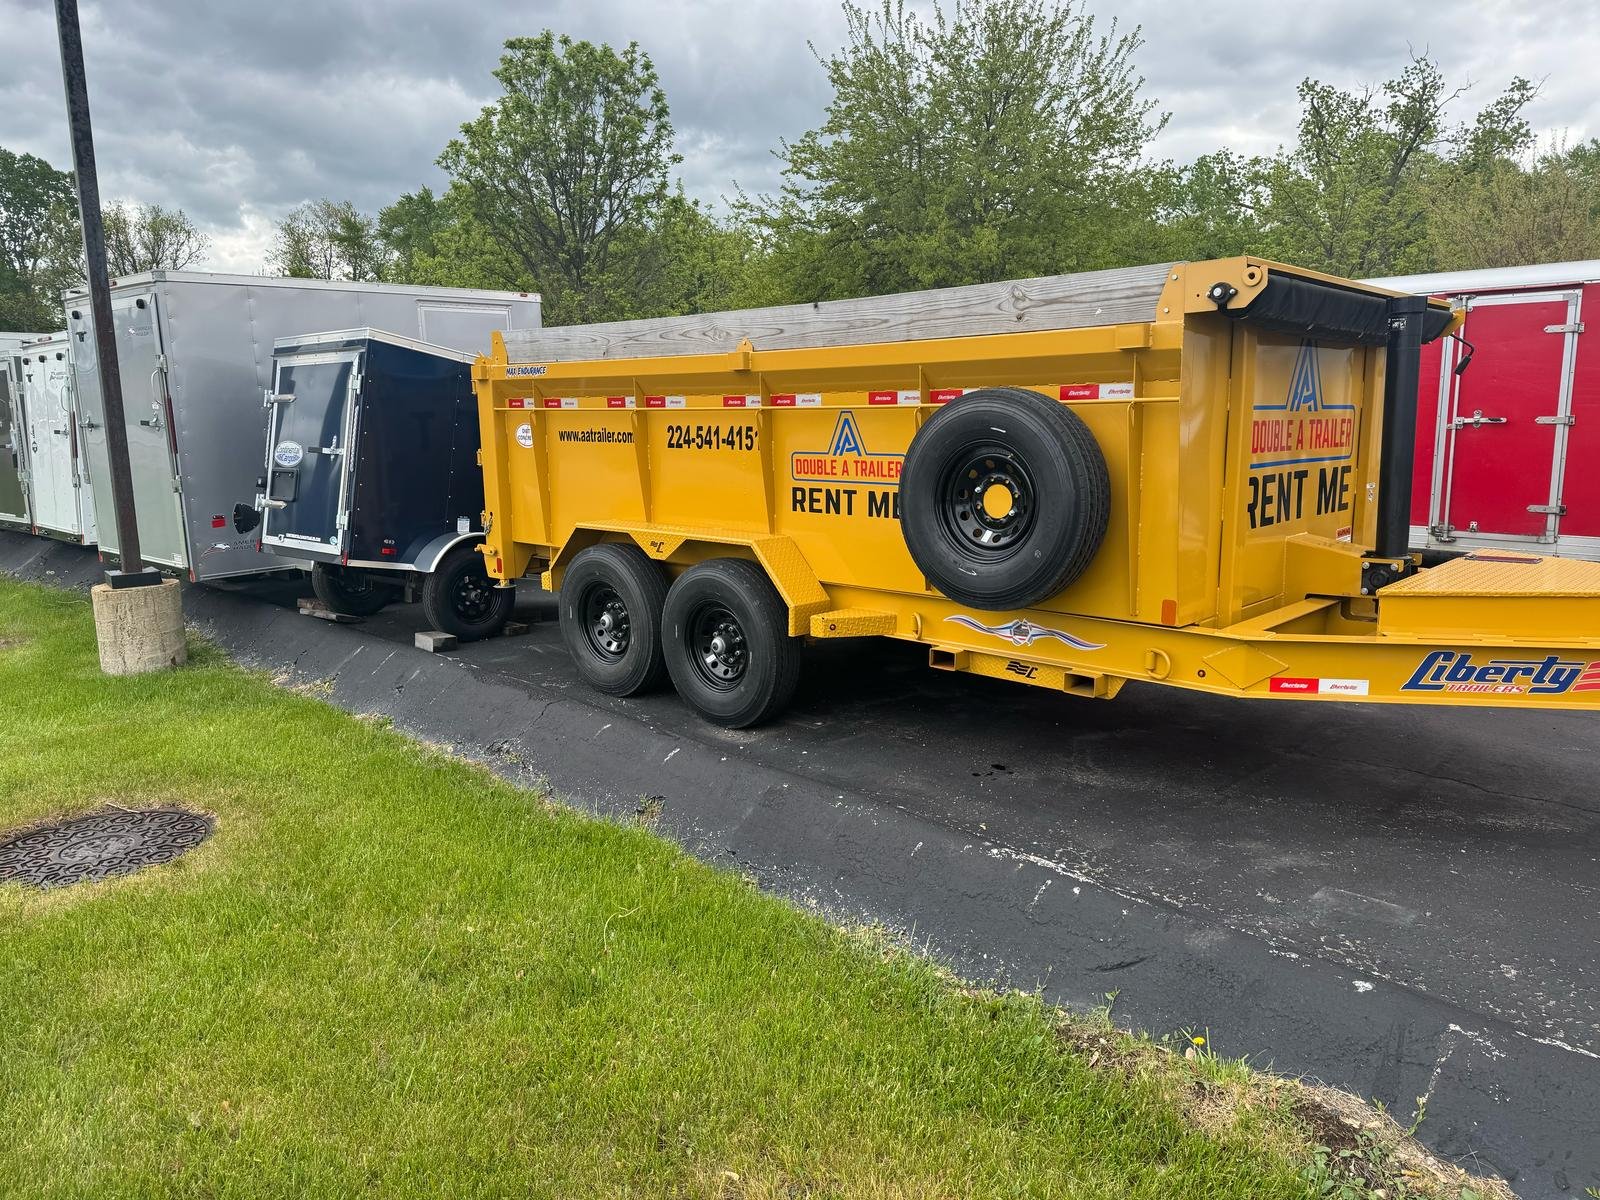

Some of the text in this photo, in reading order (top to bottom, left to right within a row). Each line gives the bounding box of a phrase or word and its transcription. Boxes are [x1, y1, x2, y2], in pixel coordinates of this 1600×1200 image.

[518, 366, 547, 376] ENDURANCE
[1252, 418, 1352, 454] DOUBLE A TRAILER
[795, 458, 904, 478] DOUBLE A TRAILER
[791, 486, 857, 516] RENT
[1247, 465, 1352, 530] RENT ME
[1400, 651, 1586, 694] Liberty
[1446, 683, 1527, 694] TRAILERS
